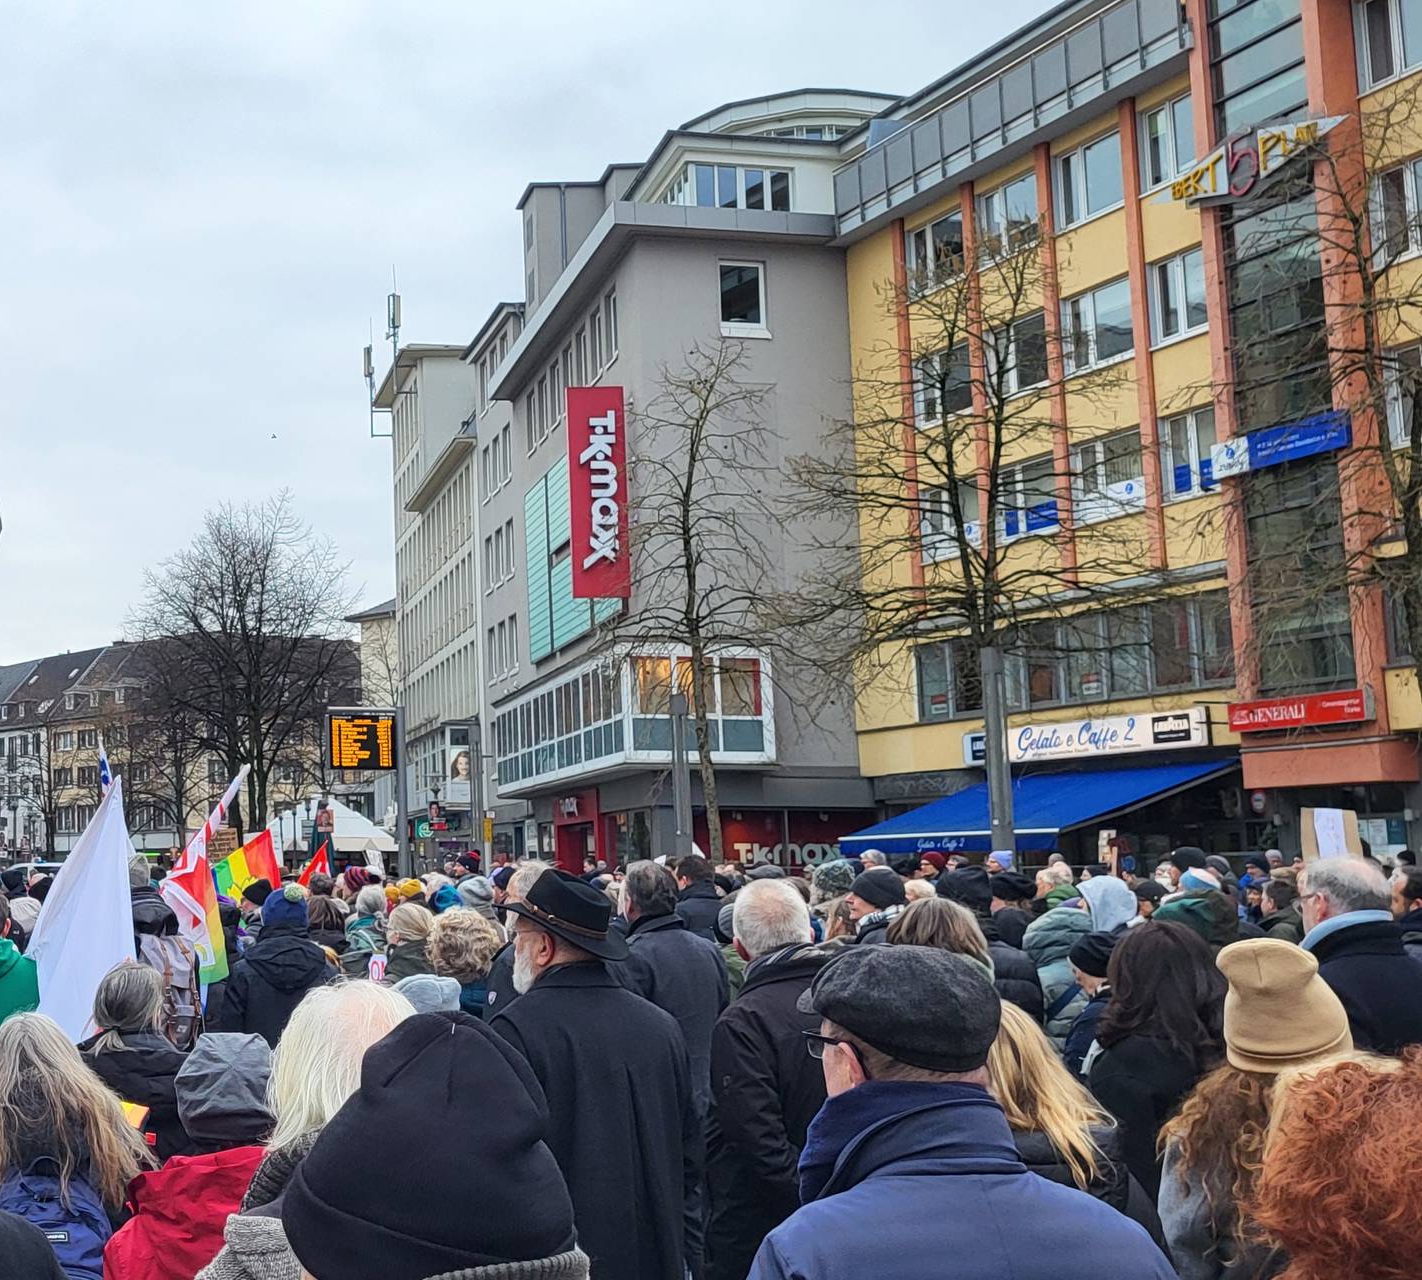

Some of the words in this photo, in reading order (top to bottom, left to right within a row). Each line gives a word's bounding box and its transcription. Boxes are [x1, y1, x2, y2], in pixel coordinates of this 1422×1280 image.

[1249, 704, 1306, 723] GENERALI
[1017, 727, 1062, 760] Gelato
[1066, 735, 1075, 747] e
[1124, 717, 1136, 742] 2
